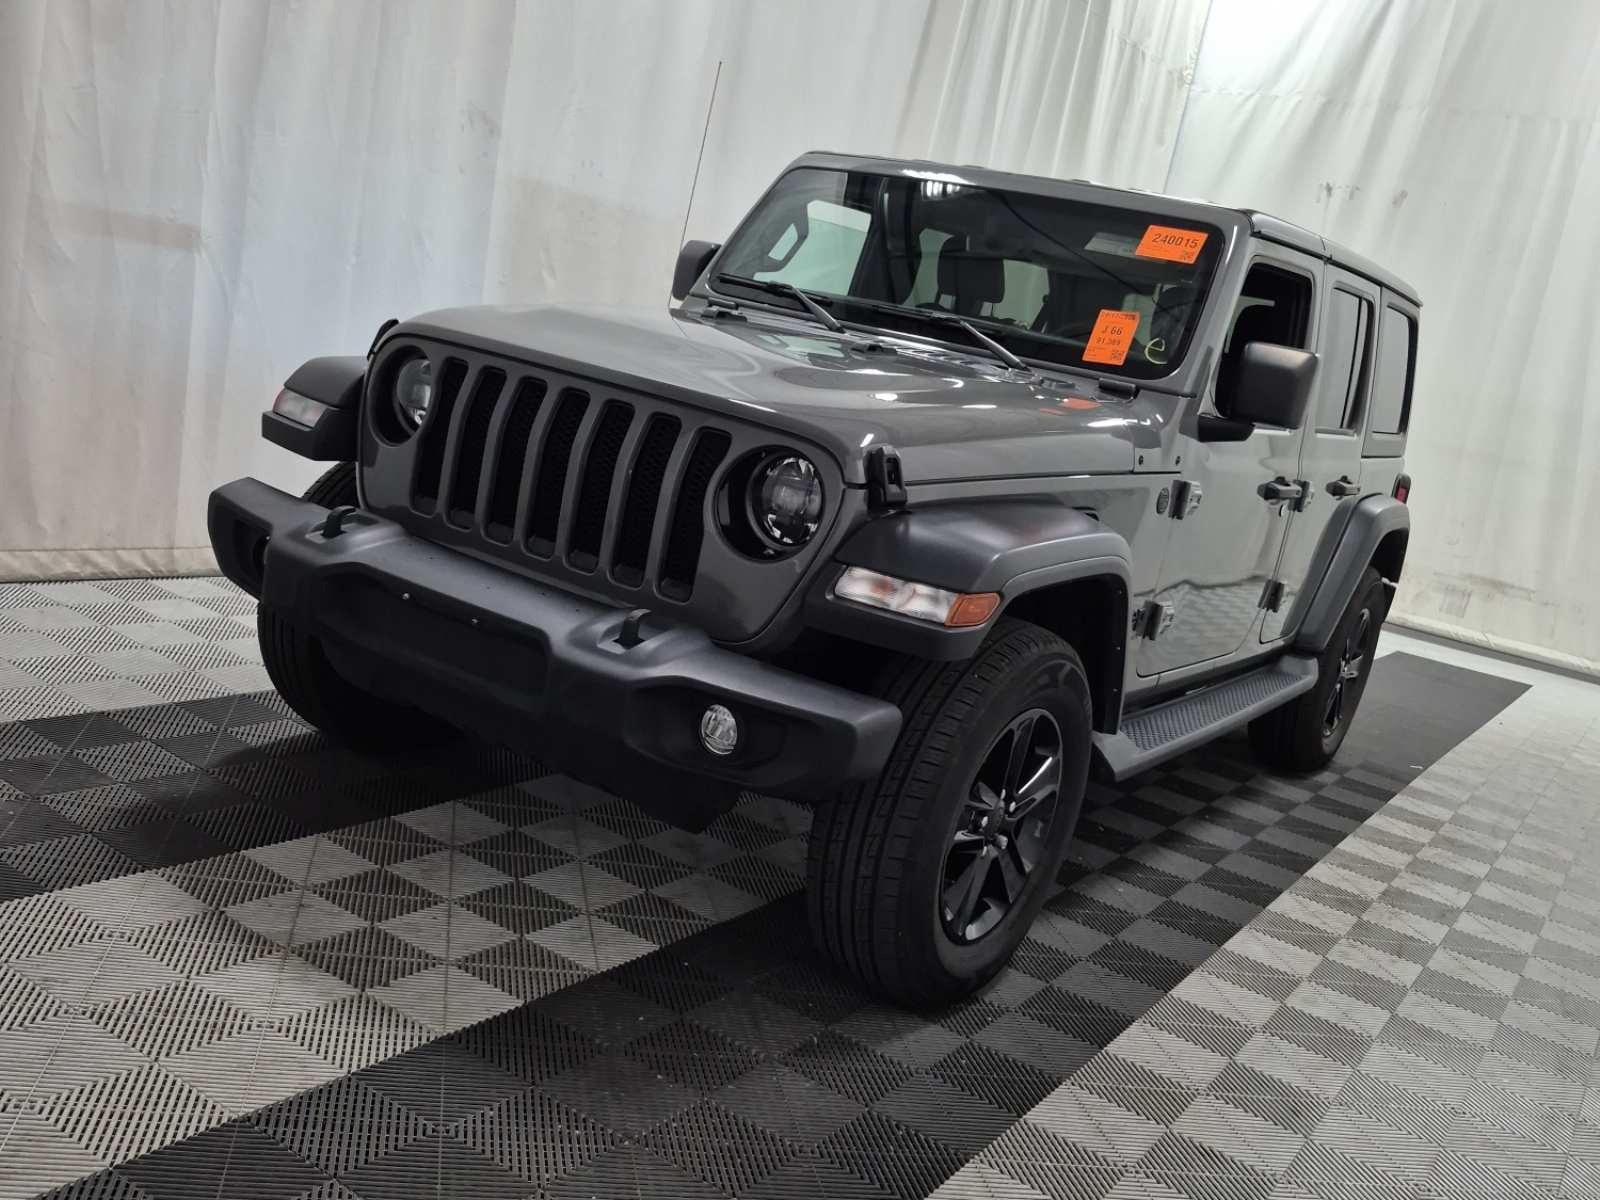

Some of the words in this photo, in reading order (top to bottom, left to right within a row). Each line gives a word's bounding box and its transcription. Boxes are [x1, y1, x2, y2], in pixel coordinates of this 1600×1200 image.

[1151, 233, 1199, 249] 240015
[1101, 325, 1109, 335] J
[1110, 327, 1123, 336] 66
